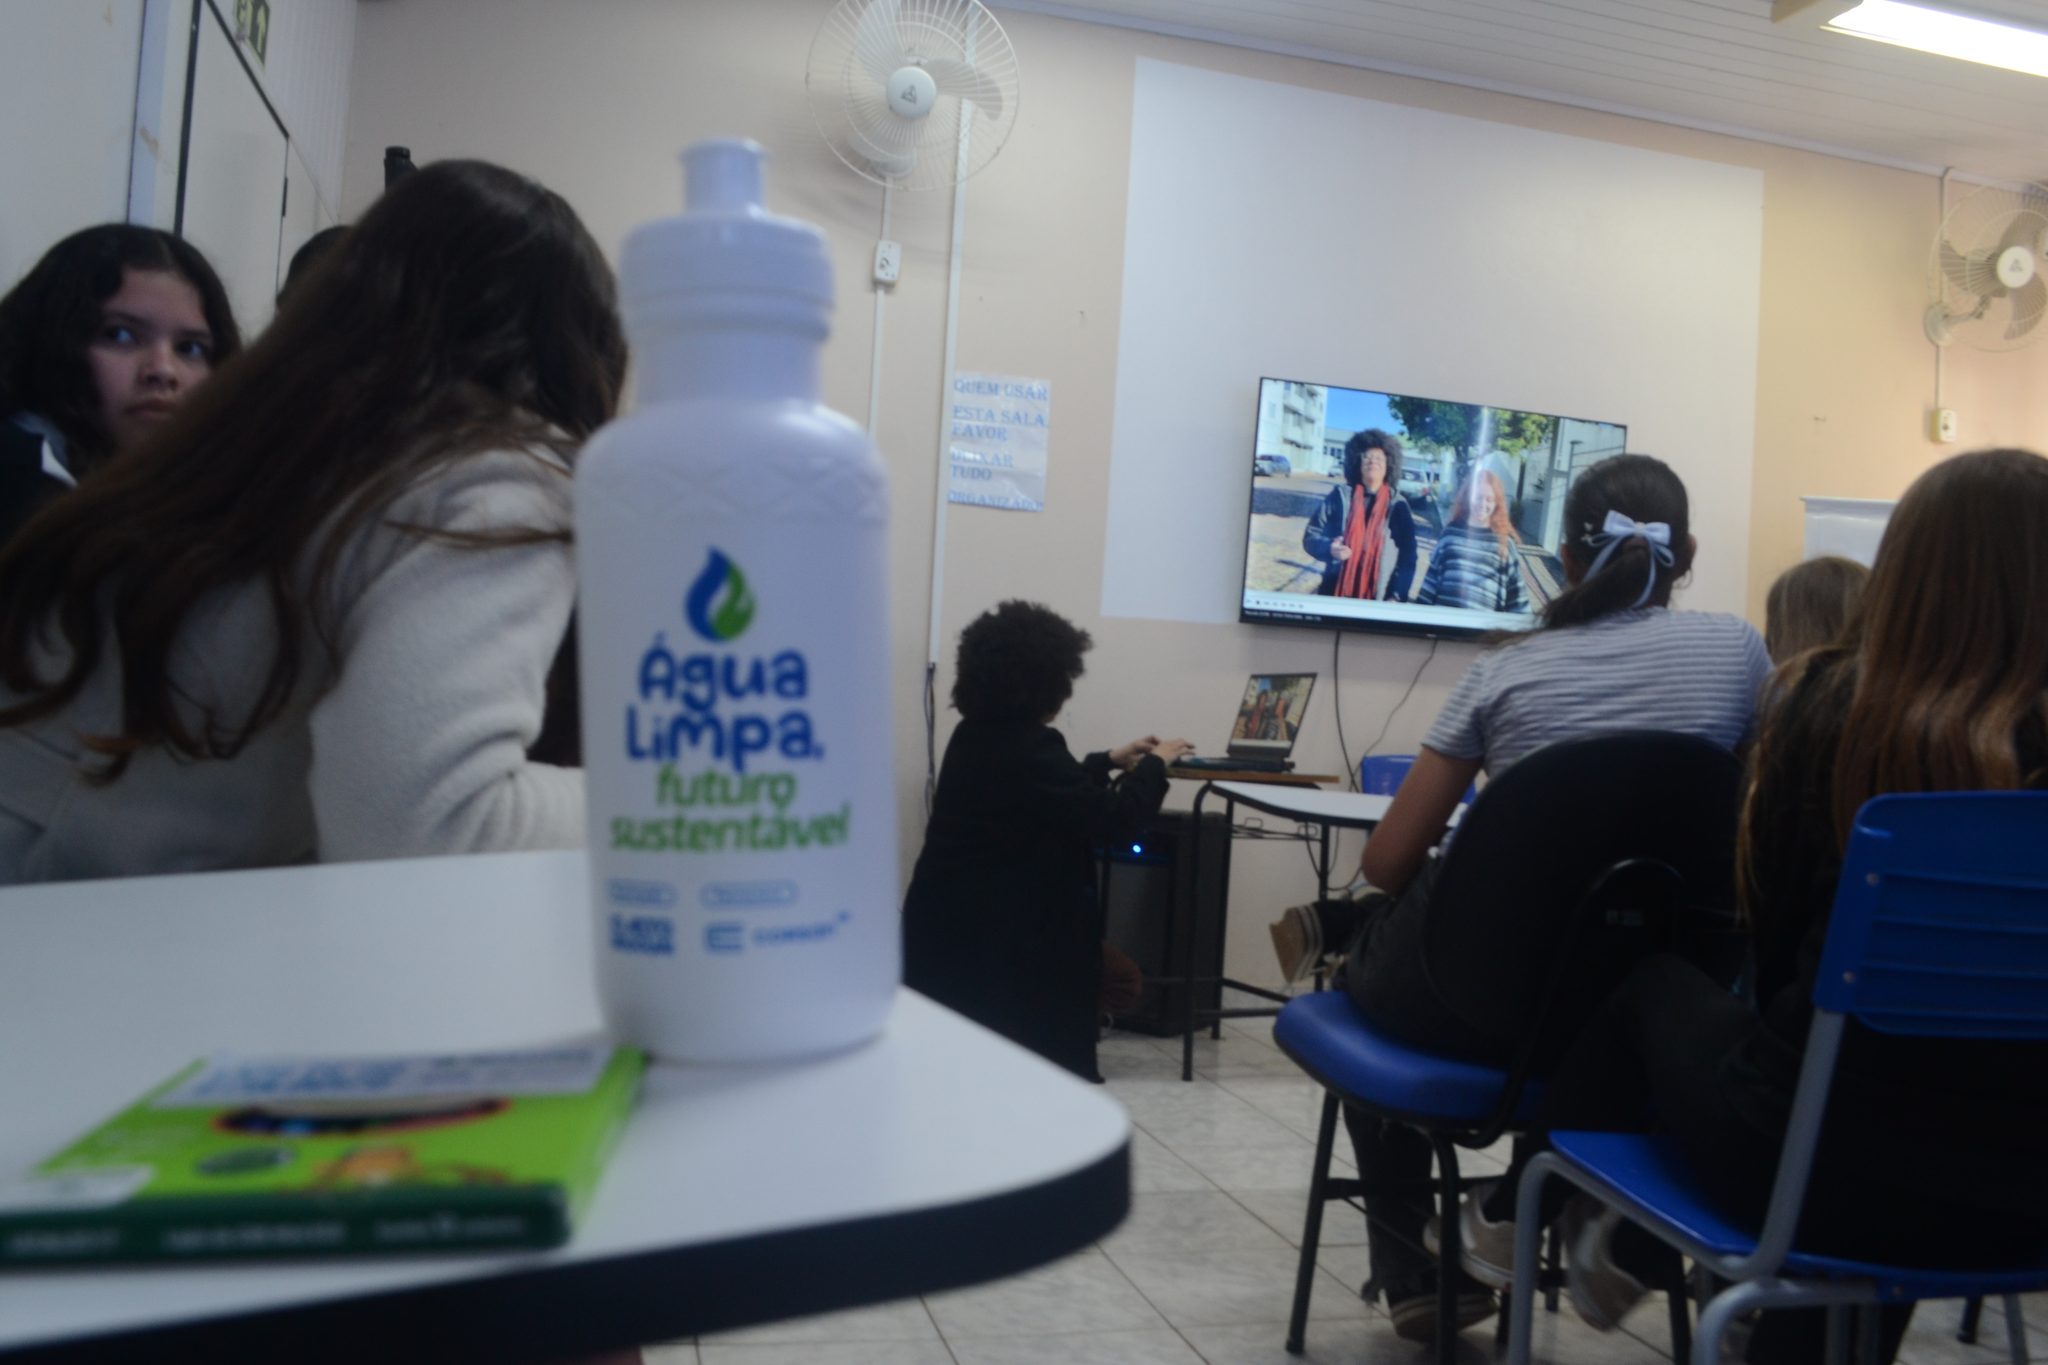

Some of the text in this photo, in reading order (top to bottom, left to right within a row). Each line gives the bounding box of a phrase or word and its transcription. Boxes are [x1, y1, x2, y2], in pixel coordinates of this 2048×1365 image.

[954, 379, 1047, 400] QUEM USAR
[953, 405, 1046, 427] ESTA SALA
[952, 424, 1008, 441] FAVOR
[952, 464, 993, 480] TUDO
[639, 631, 808, 712] Água
[657, 763, 796, 808] futuro
[610, 802, 851, 851] sustentável
